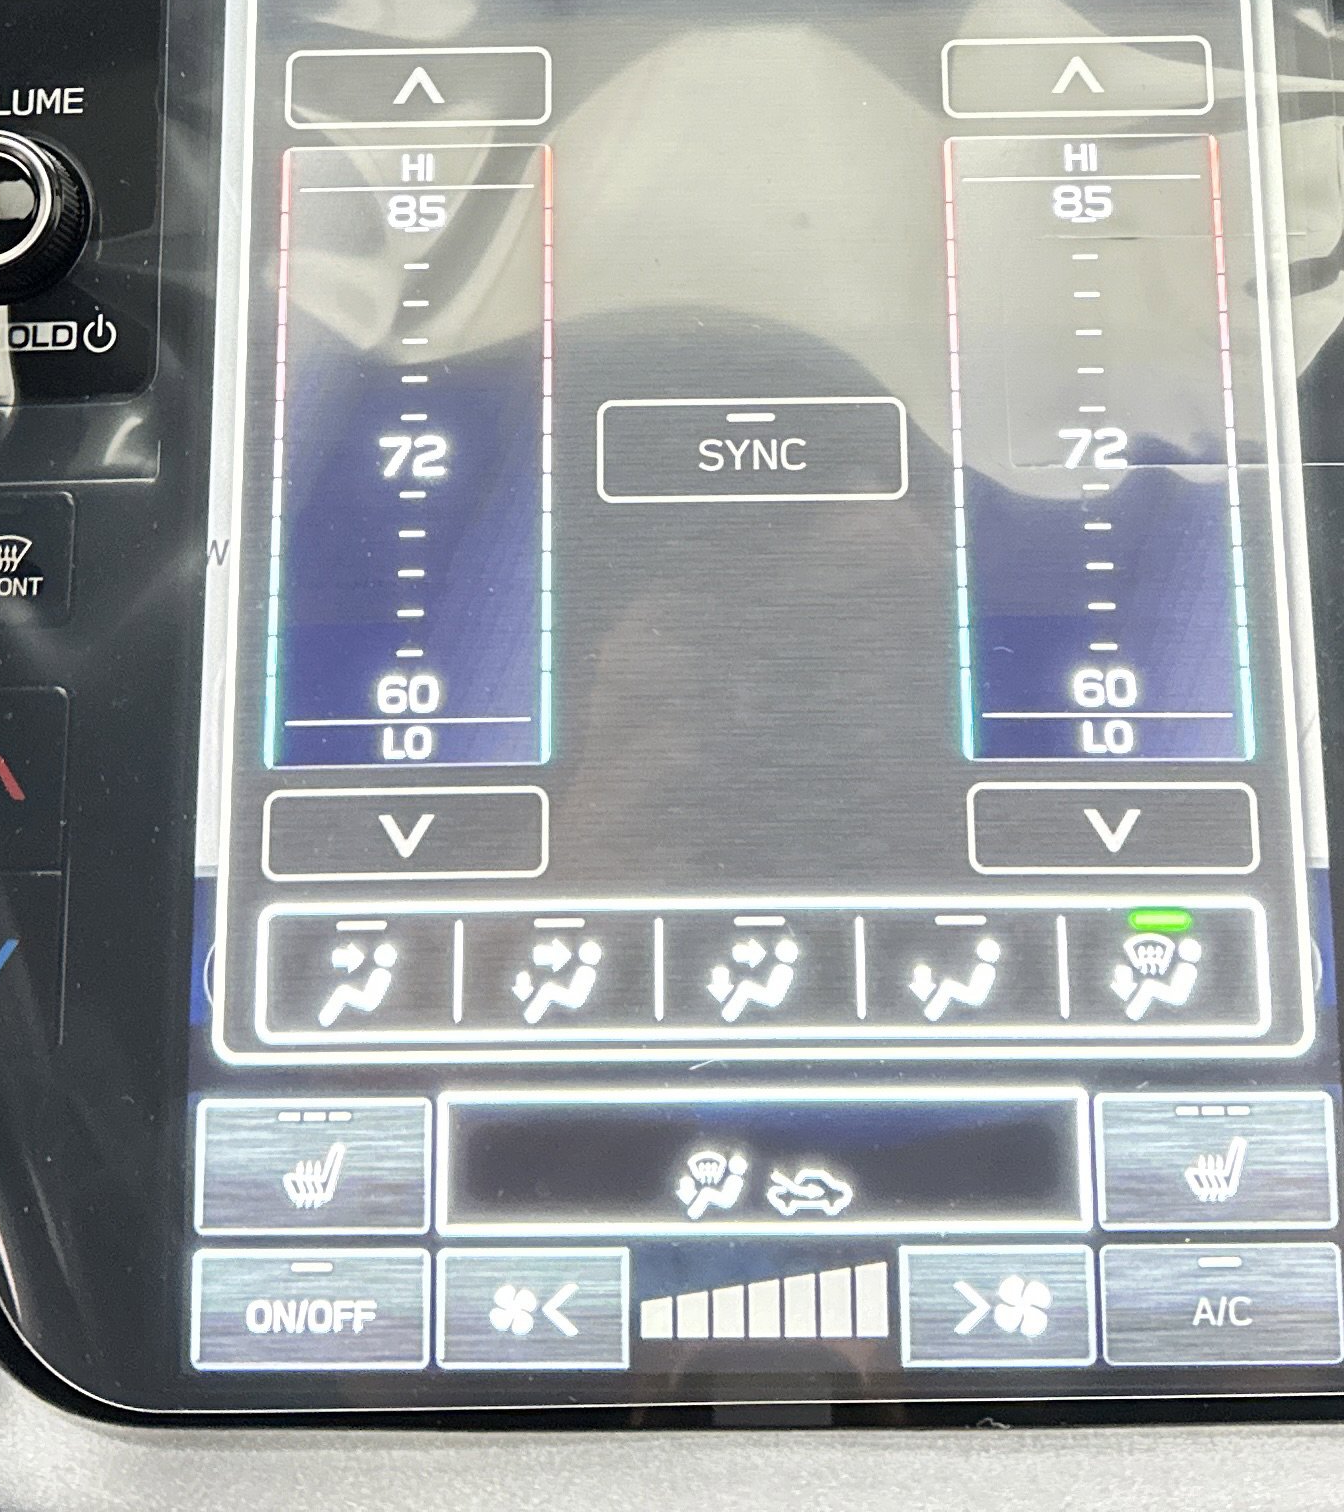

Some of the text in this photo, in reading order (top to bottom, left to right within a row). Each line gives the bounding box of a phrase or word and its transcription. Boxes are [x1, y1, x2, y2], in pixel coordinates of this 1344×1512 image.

[401, 153, 435, 183] HI
[1063, 143, 1098, 173] HI
[387, 194, 447, 230] 85
[1053, 184, 1113, 219] 85
[378, 436, 448, 479] 72
[697, 439, 808, 473] SYNC
[1059, 429, 1128, 471] 72
[375, 675, 441, 715] 60
[1072, 669, 1139, 708] 60
[382, 728, 432, 760] LO
[1082, 721, 1134, 754] LO
[245, 1300, 377, 1334] ON/OFF
[1191, 1296, 1254, 1327] A/C
